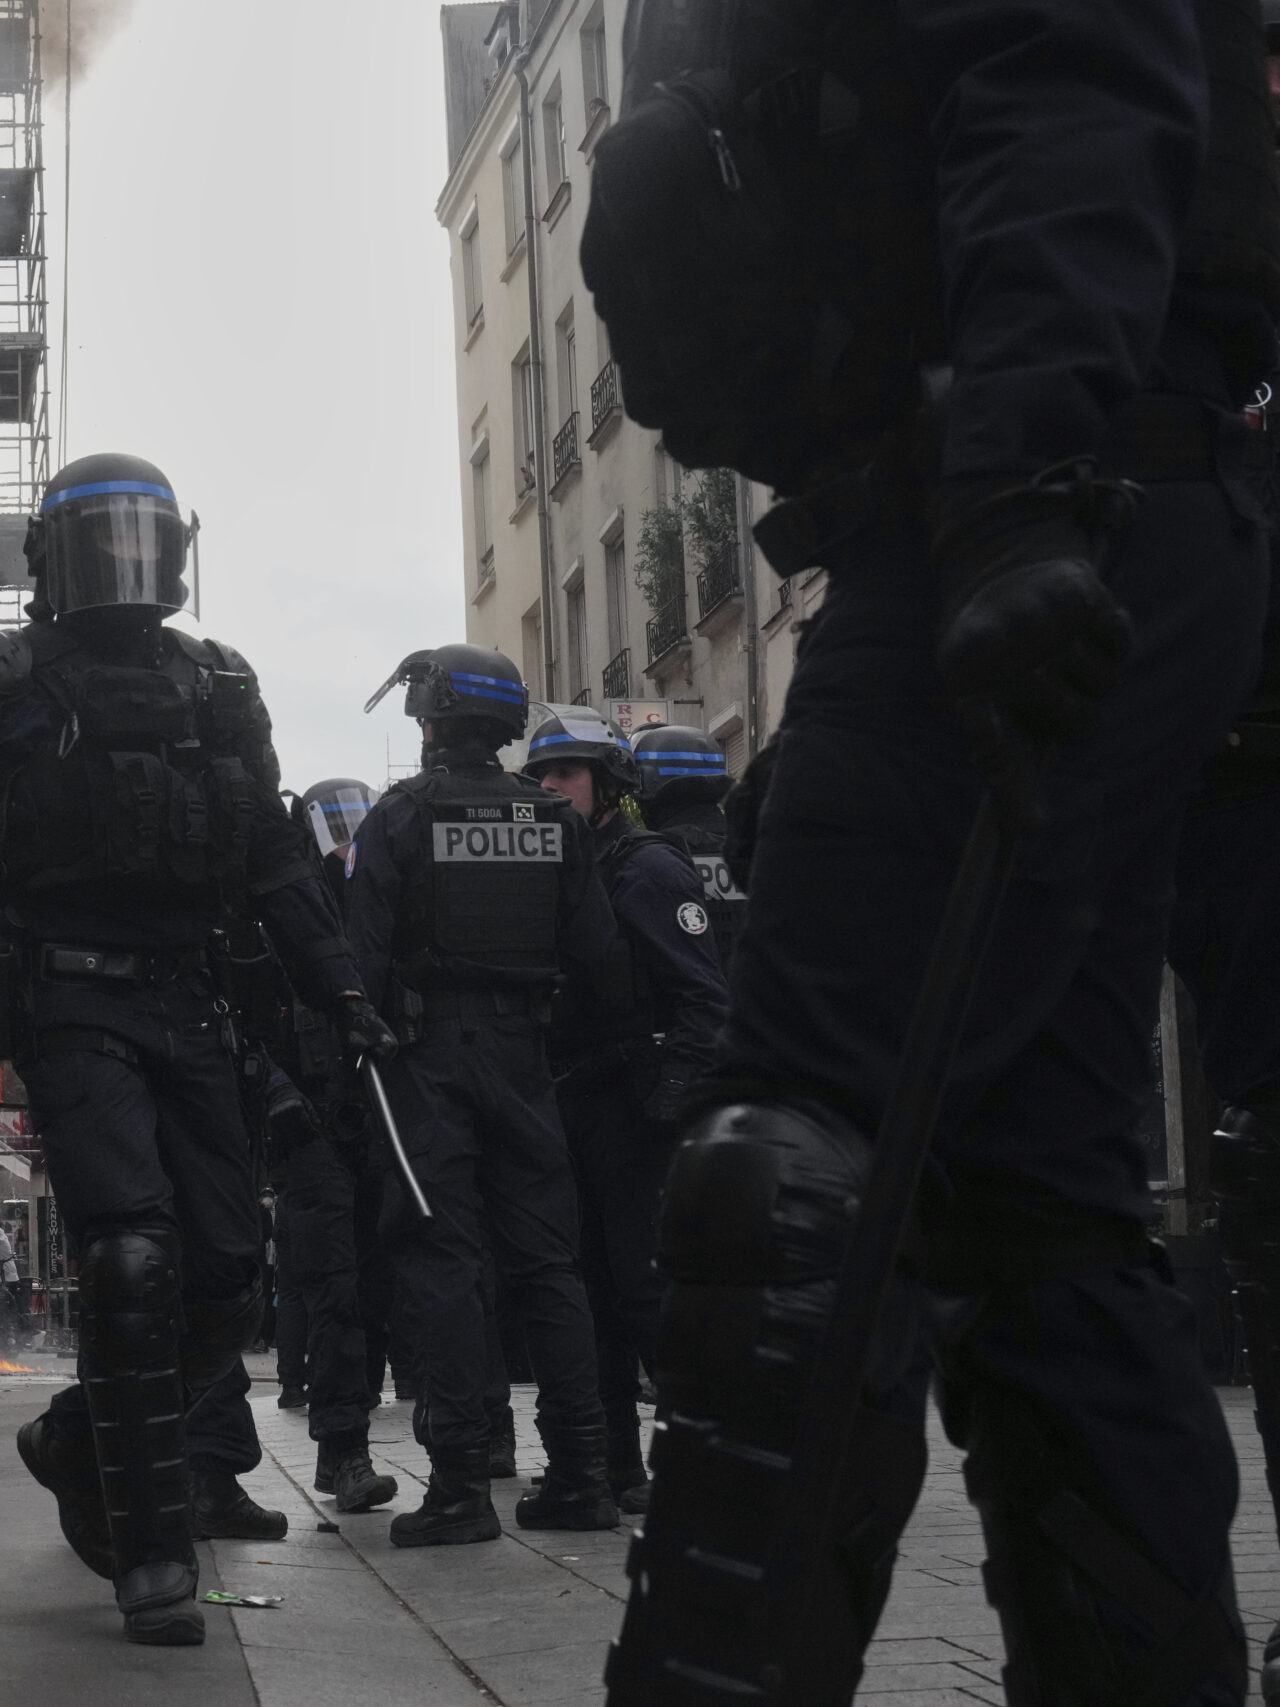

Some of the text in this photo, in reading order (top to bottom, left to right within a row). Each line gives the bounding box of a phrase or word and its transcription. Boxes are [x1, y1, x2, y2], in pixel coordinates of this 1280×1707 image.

[466, 808, 502, 818] TI 500A
[446, 826, 557, 857] POLICE
[48, 1197, 59, 1273] SANDWICHES
